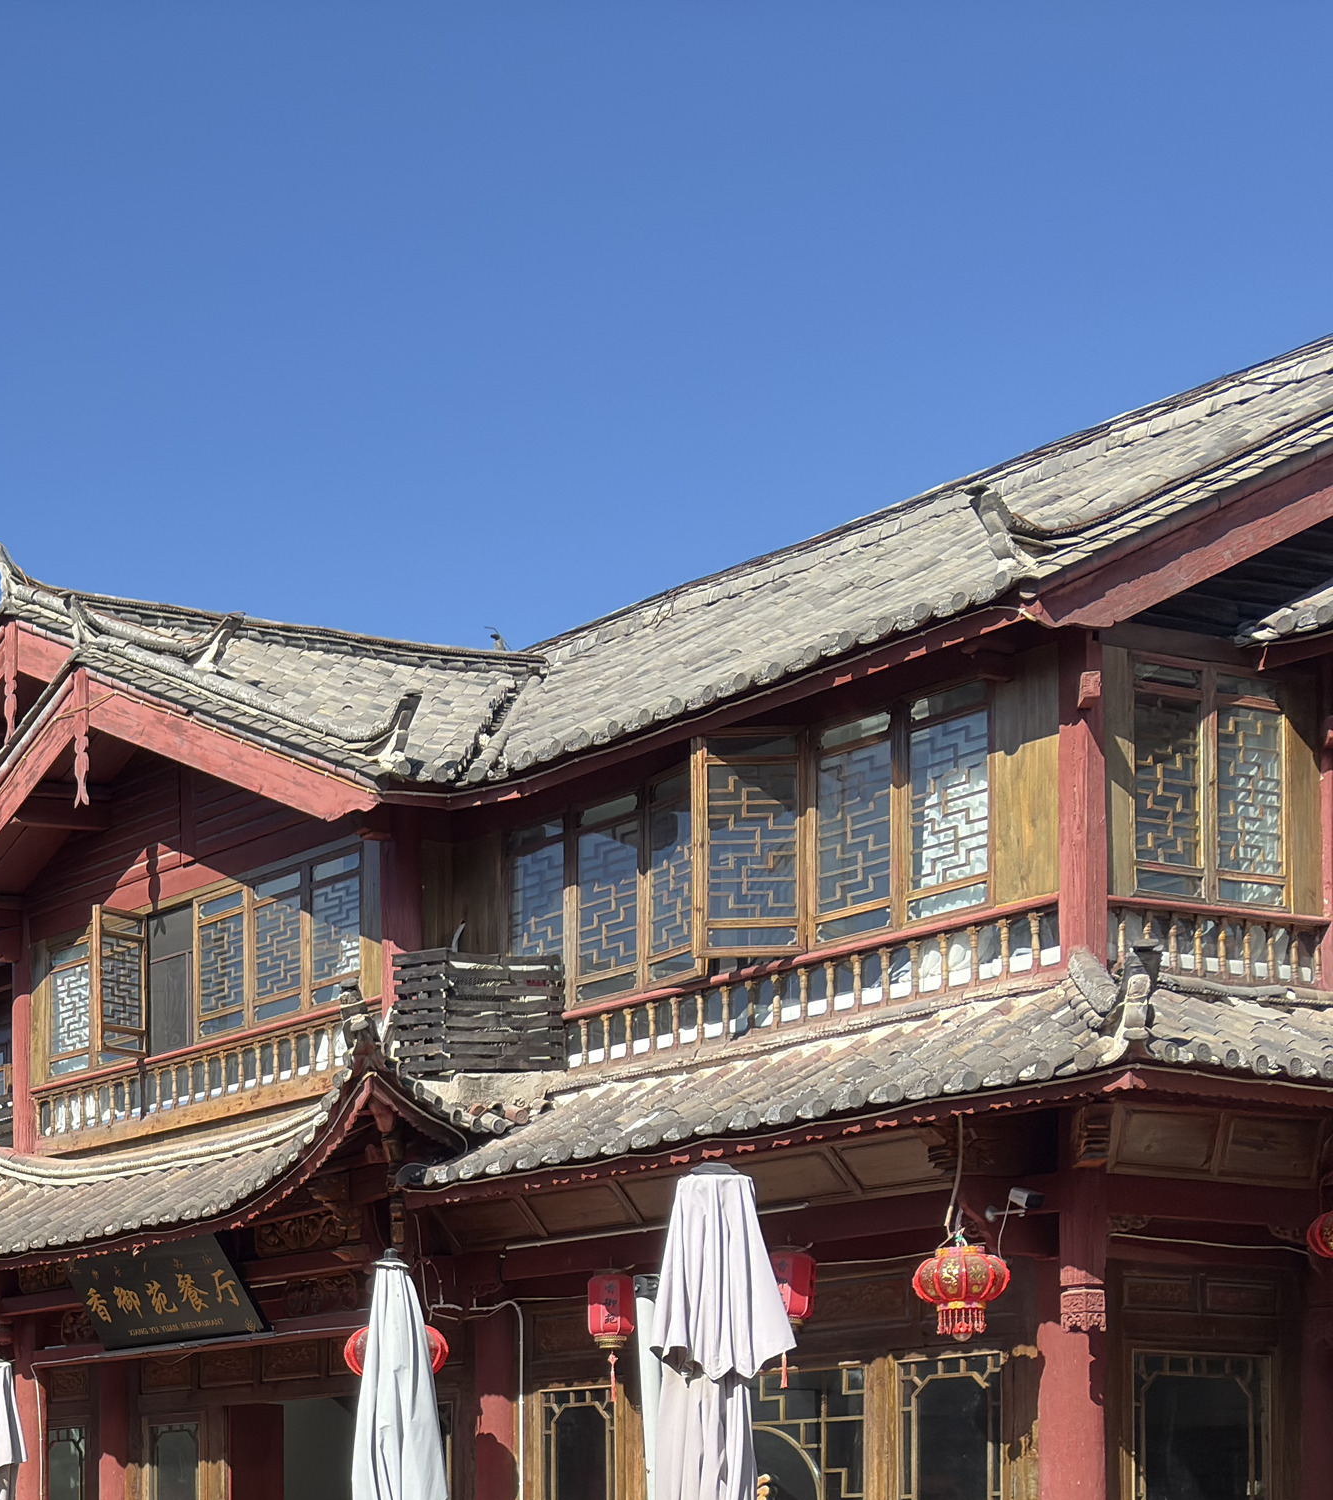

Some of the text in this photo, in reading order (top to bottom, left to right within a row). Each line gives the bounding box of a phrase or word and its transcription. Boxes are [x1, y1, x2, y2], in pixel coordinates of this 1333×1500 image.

[86, 1268, 240, 1324] 香御苑餐厅
[604, 1281, 618, 1325] 香御苑
[128, 1318, 224, 1337] XIANG YU YUAN RESTAURANT
